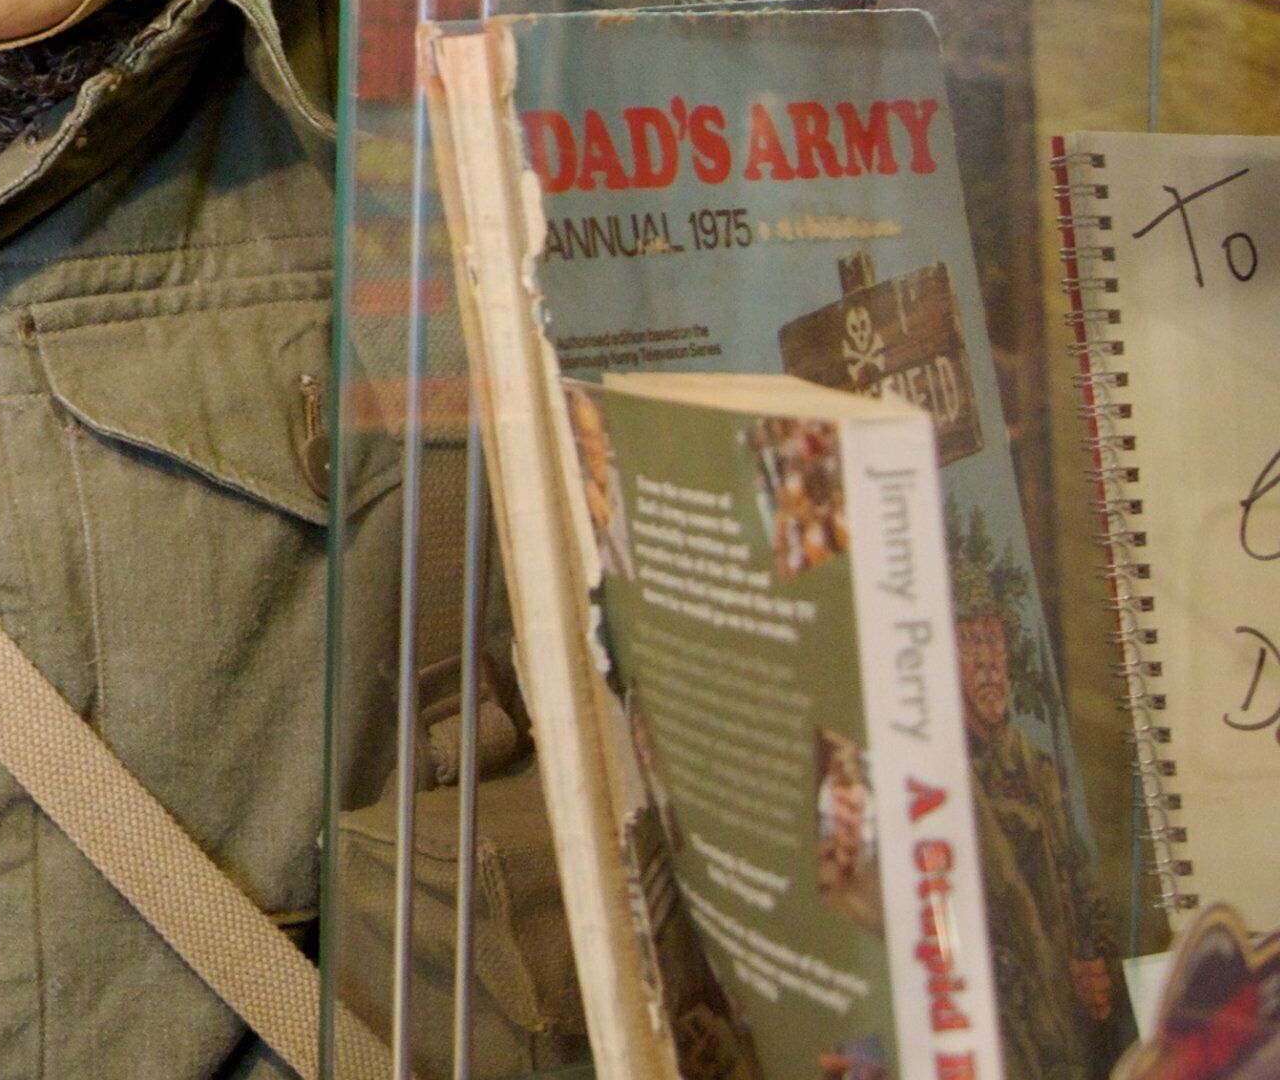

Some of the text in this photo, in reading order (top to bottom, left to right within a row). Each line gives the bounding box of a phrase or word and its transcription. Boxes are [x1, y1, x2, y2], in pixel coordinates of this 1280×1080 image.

[520, 95, 940, 194] DAD'S ARMY
[542, 211, 685, 263] ANNUAL
[688, 208, 754, 251] 1975
[866, 466, 917, 603] Jimmy
[889, 619, 933, 743] Perry
[906, 776, 948, 822] A
